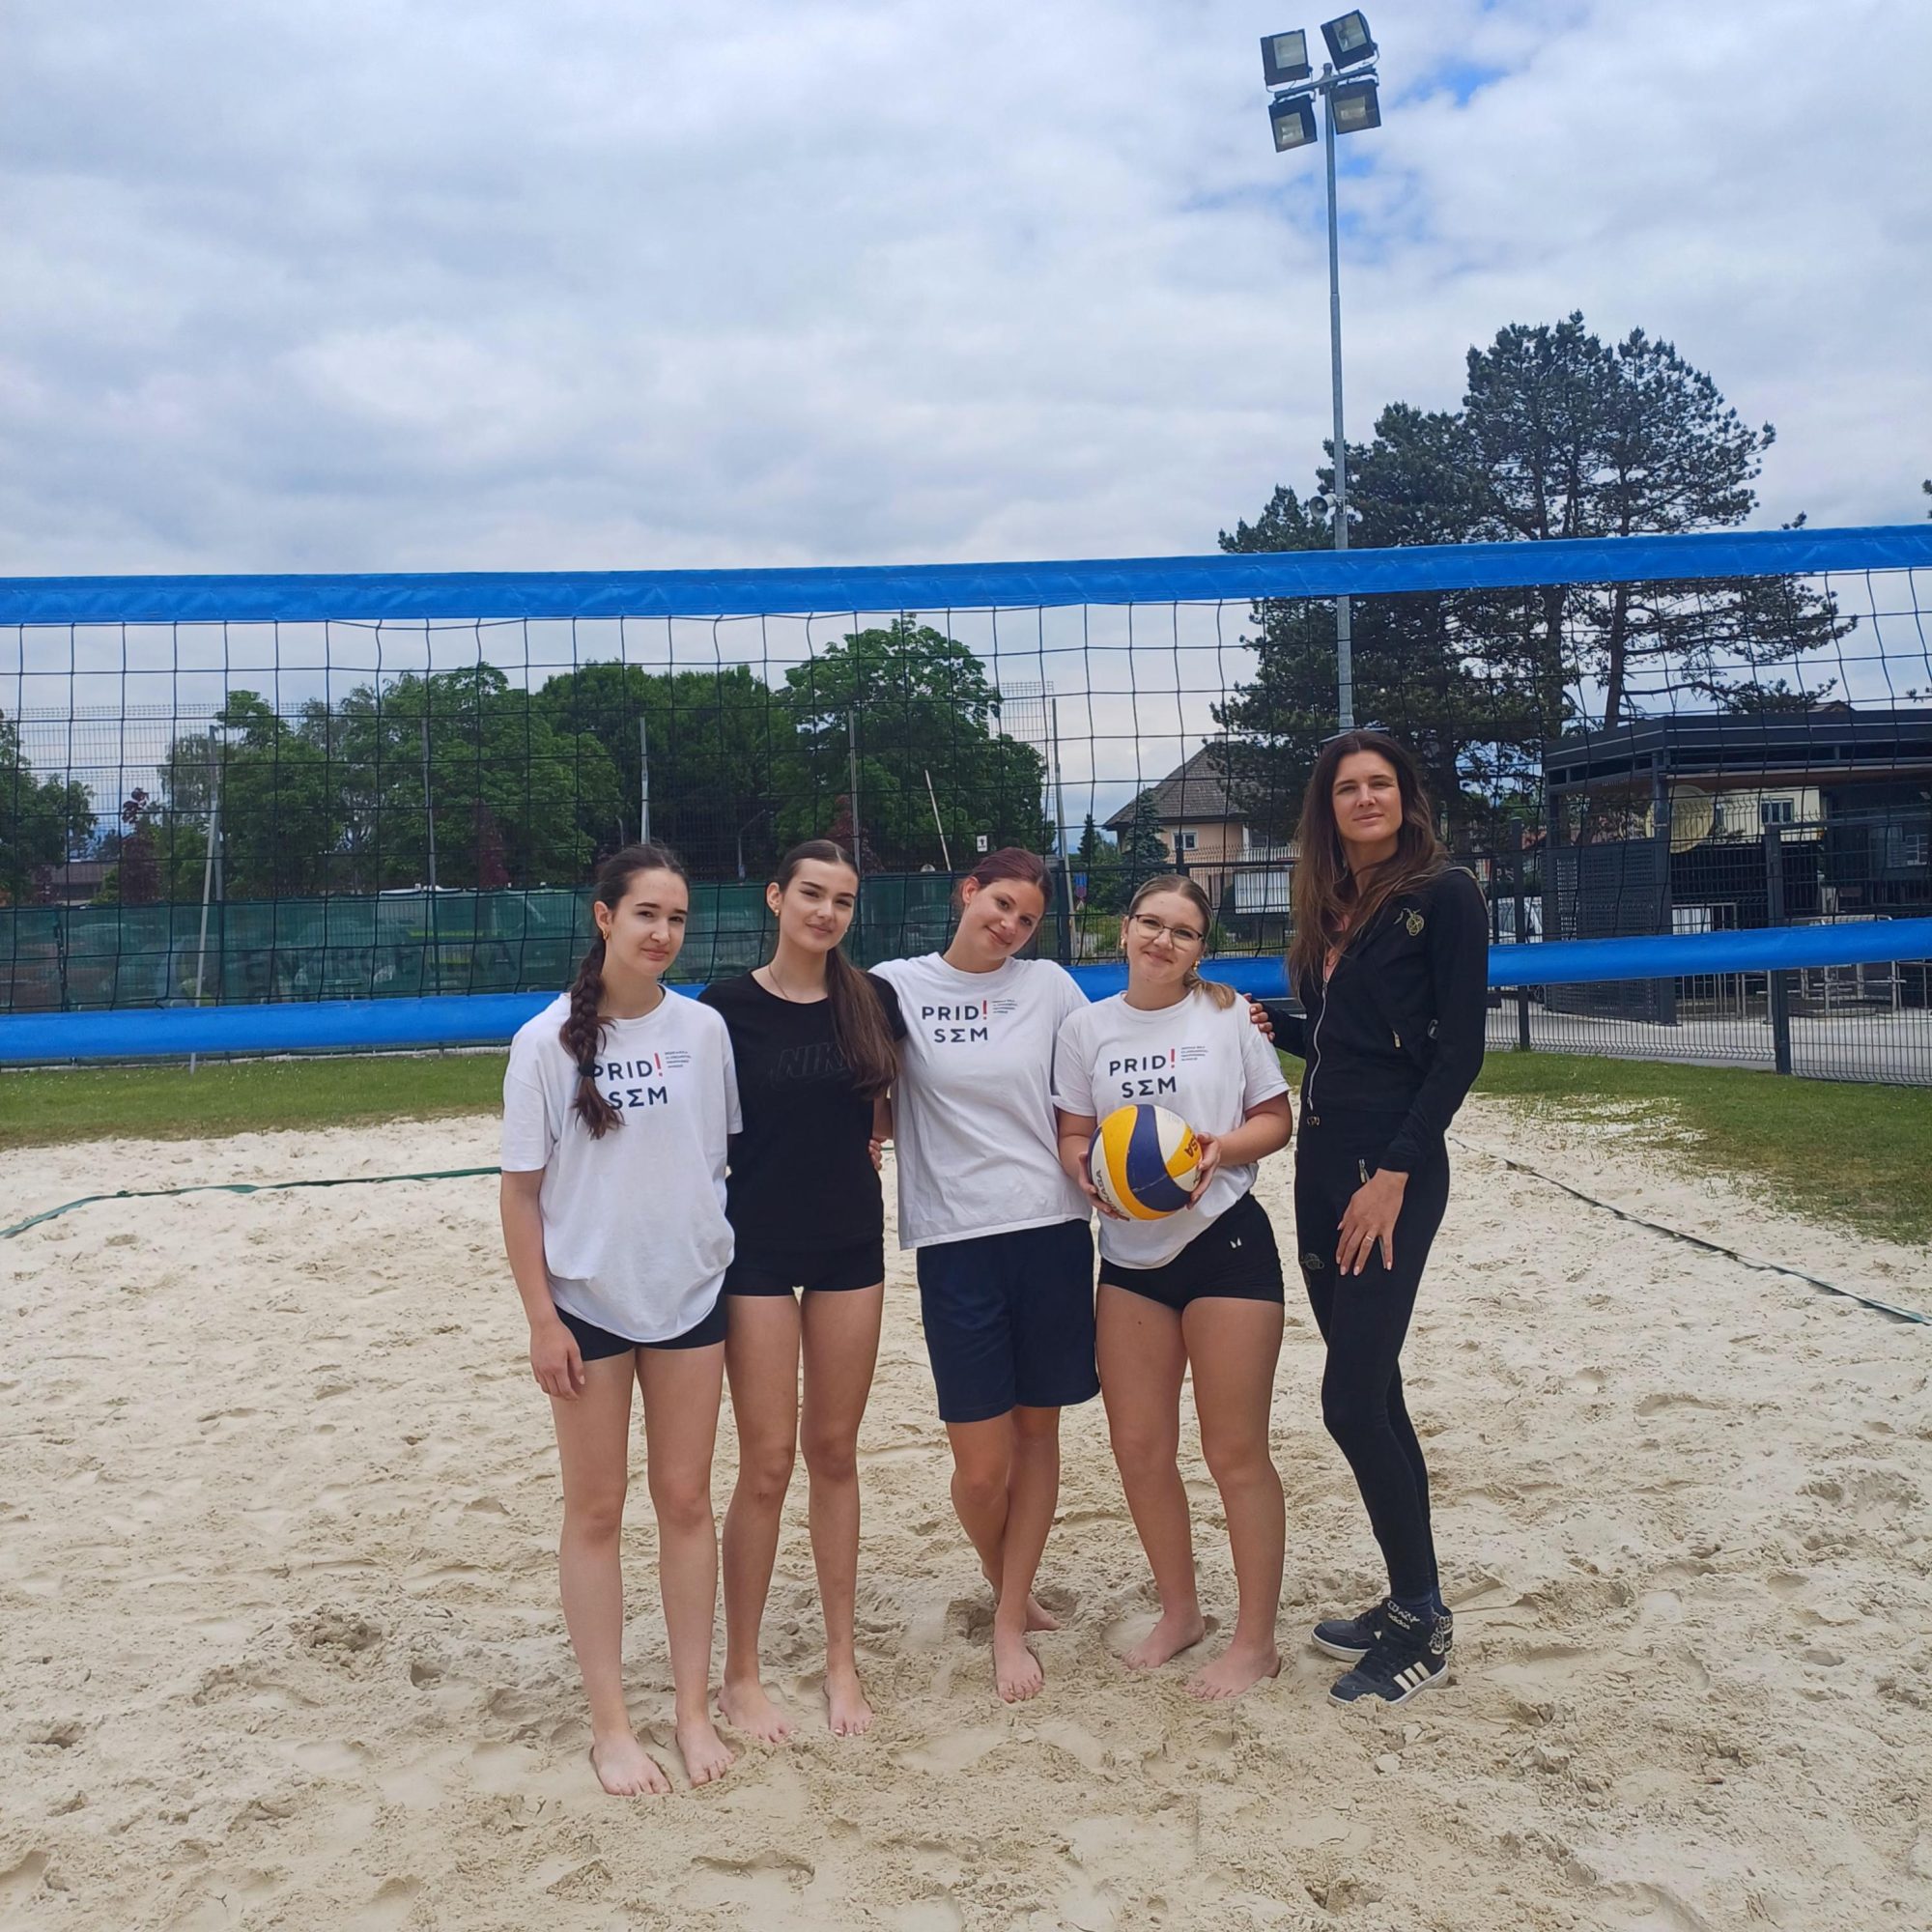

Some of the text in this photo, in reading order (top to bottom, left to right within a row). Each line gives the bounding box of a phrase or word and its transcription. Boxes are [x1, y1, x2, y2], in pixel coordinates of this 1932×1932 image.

[921, 999, 988, 1021] PRID!
[777, 1040, 849, 1079] NIK
[1108, 1047, 1176, 1077] PRID!
